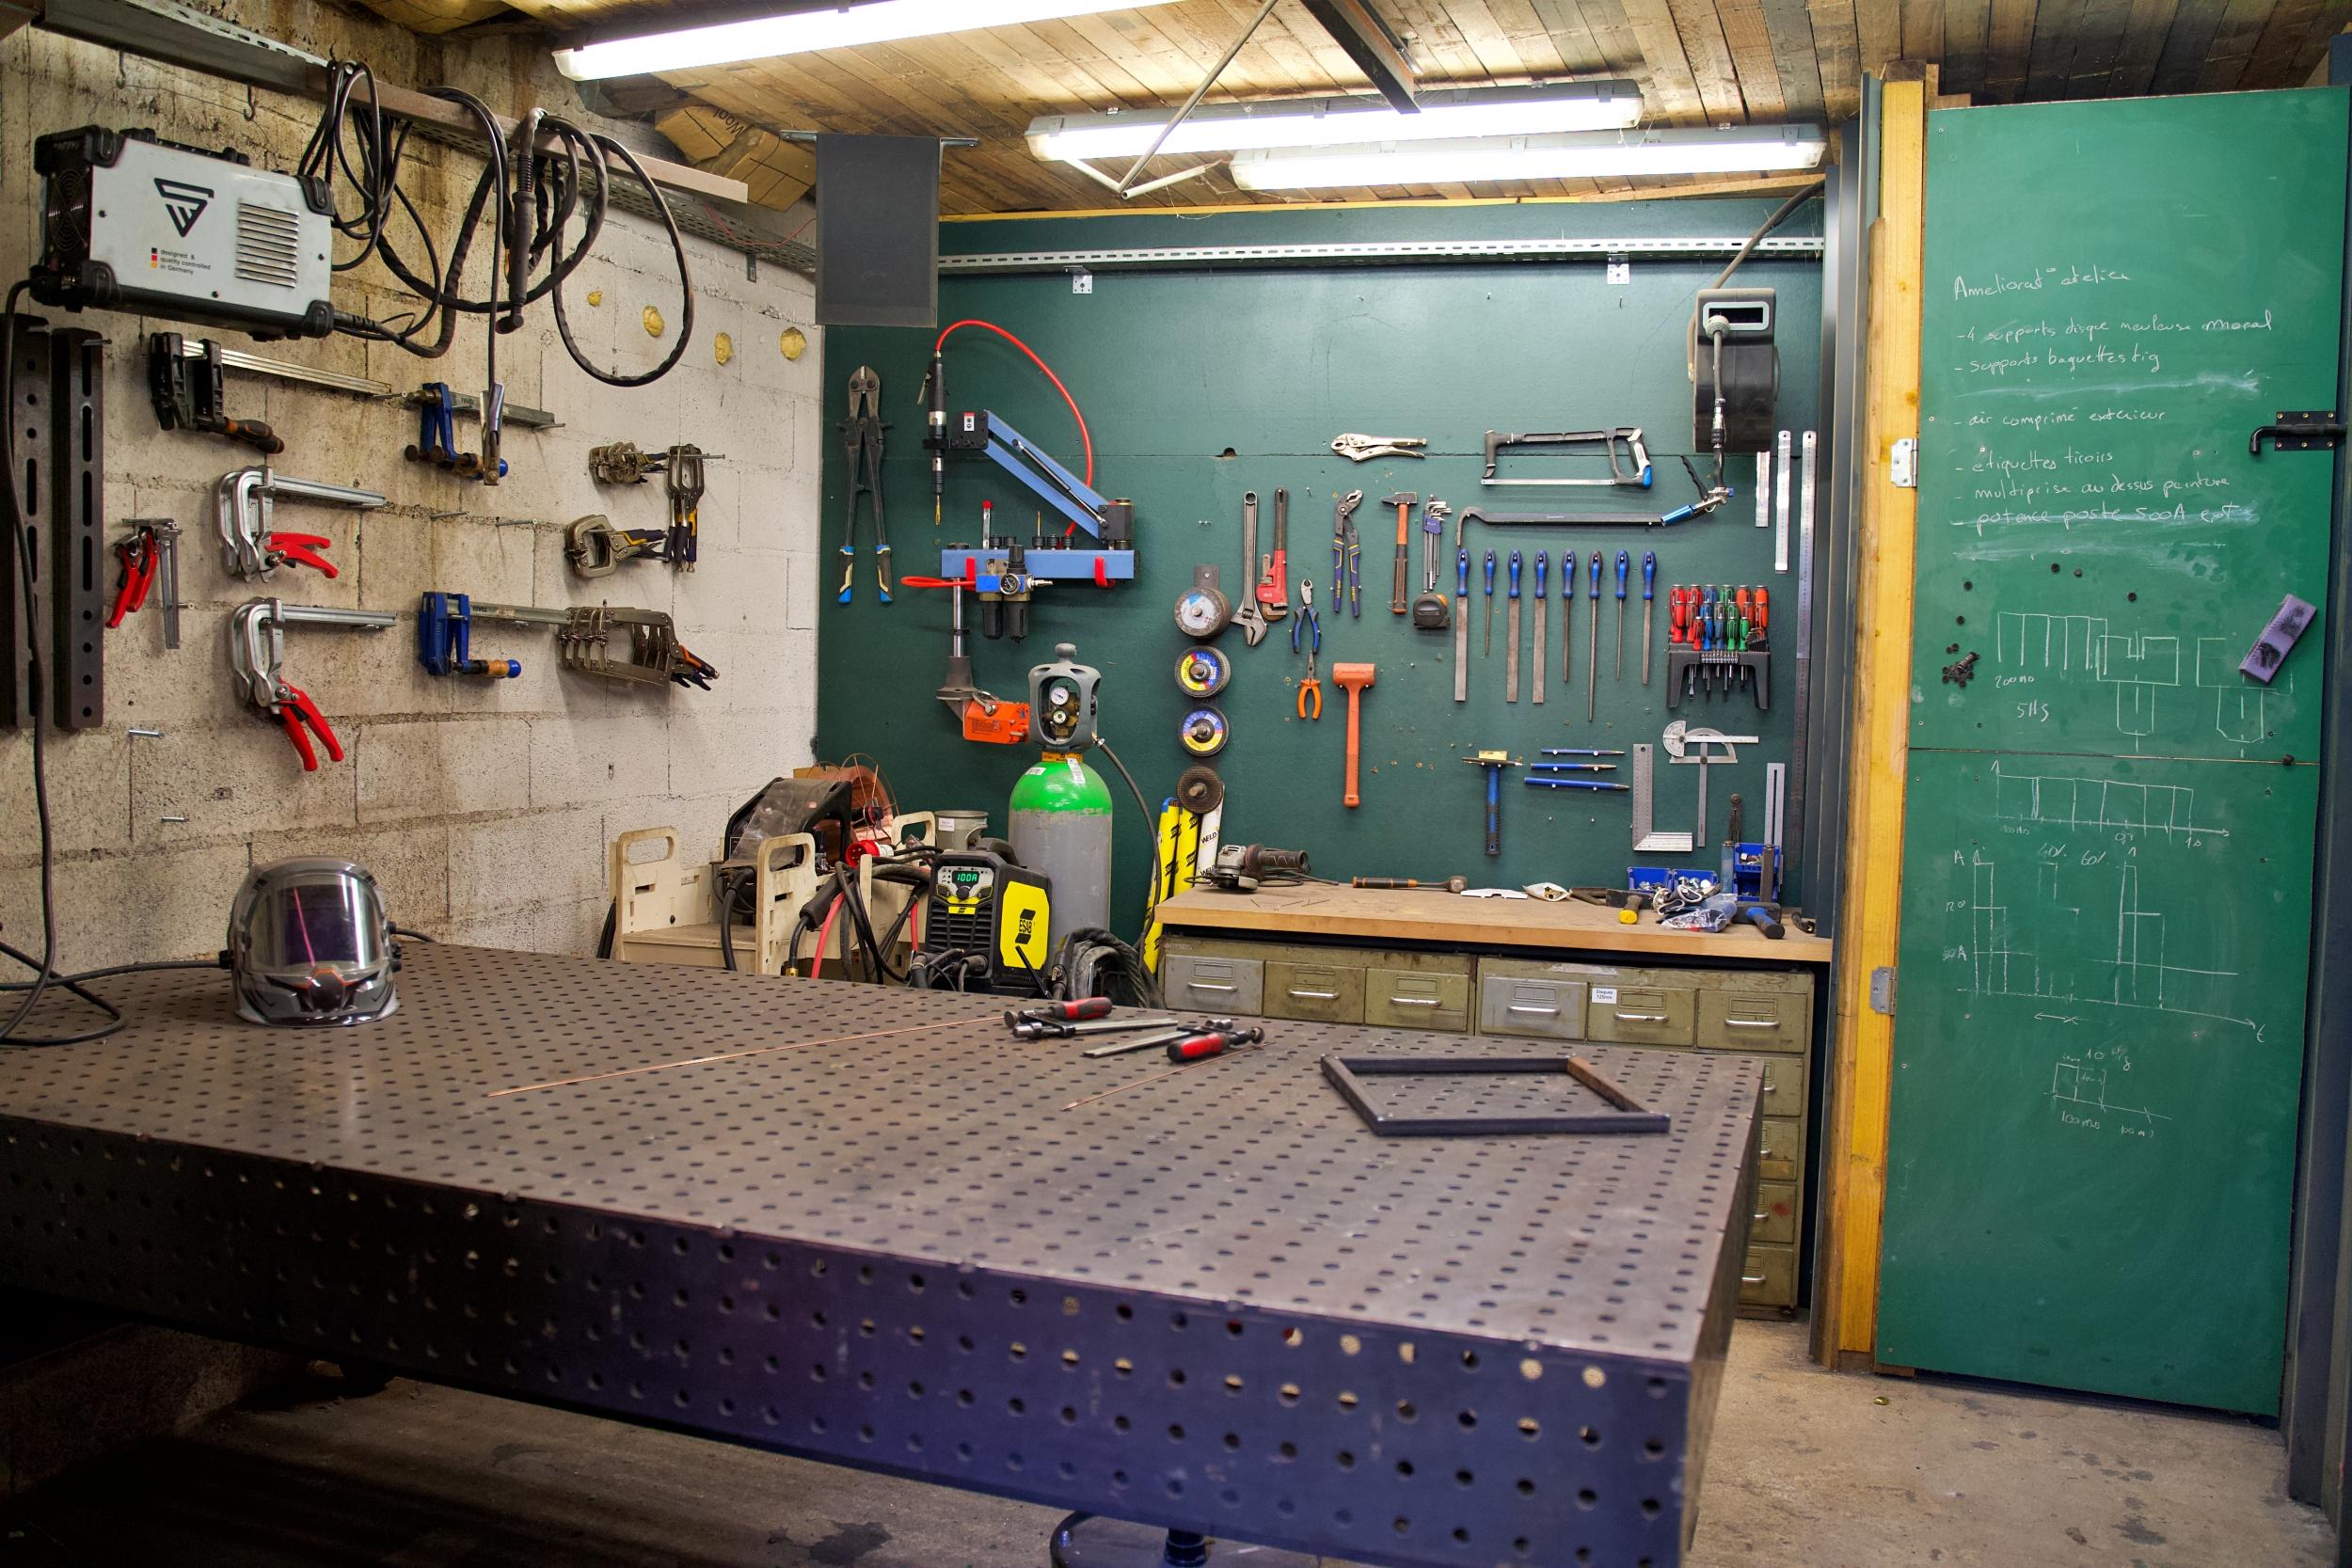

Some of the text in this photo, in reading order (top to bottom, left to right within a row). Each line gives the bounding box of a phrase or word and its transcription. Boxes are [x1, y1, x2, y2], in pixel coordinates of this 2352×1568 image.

[160, 249, 187, 259] designed
[160, 257, 212, 271] quality controlled
[167, 264, 194, 276] Germany
[1201, 832, 1217, 844] WELD
[957, 873, 977, 882] 100A
[1019, 919, 1033, 934] ESAB
